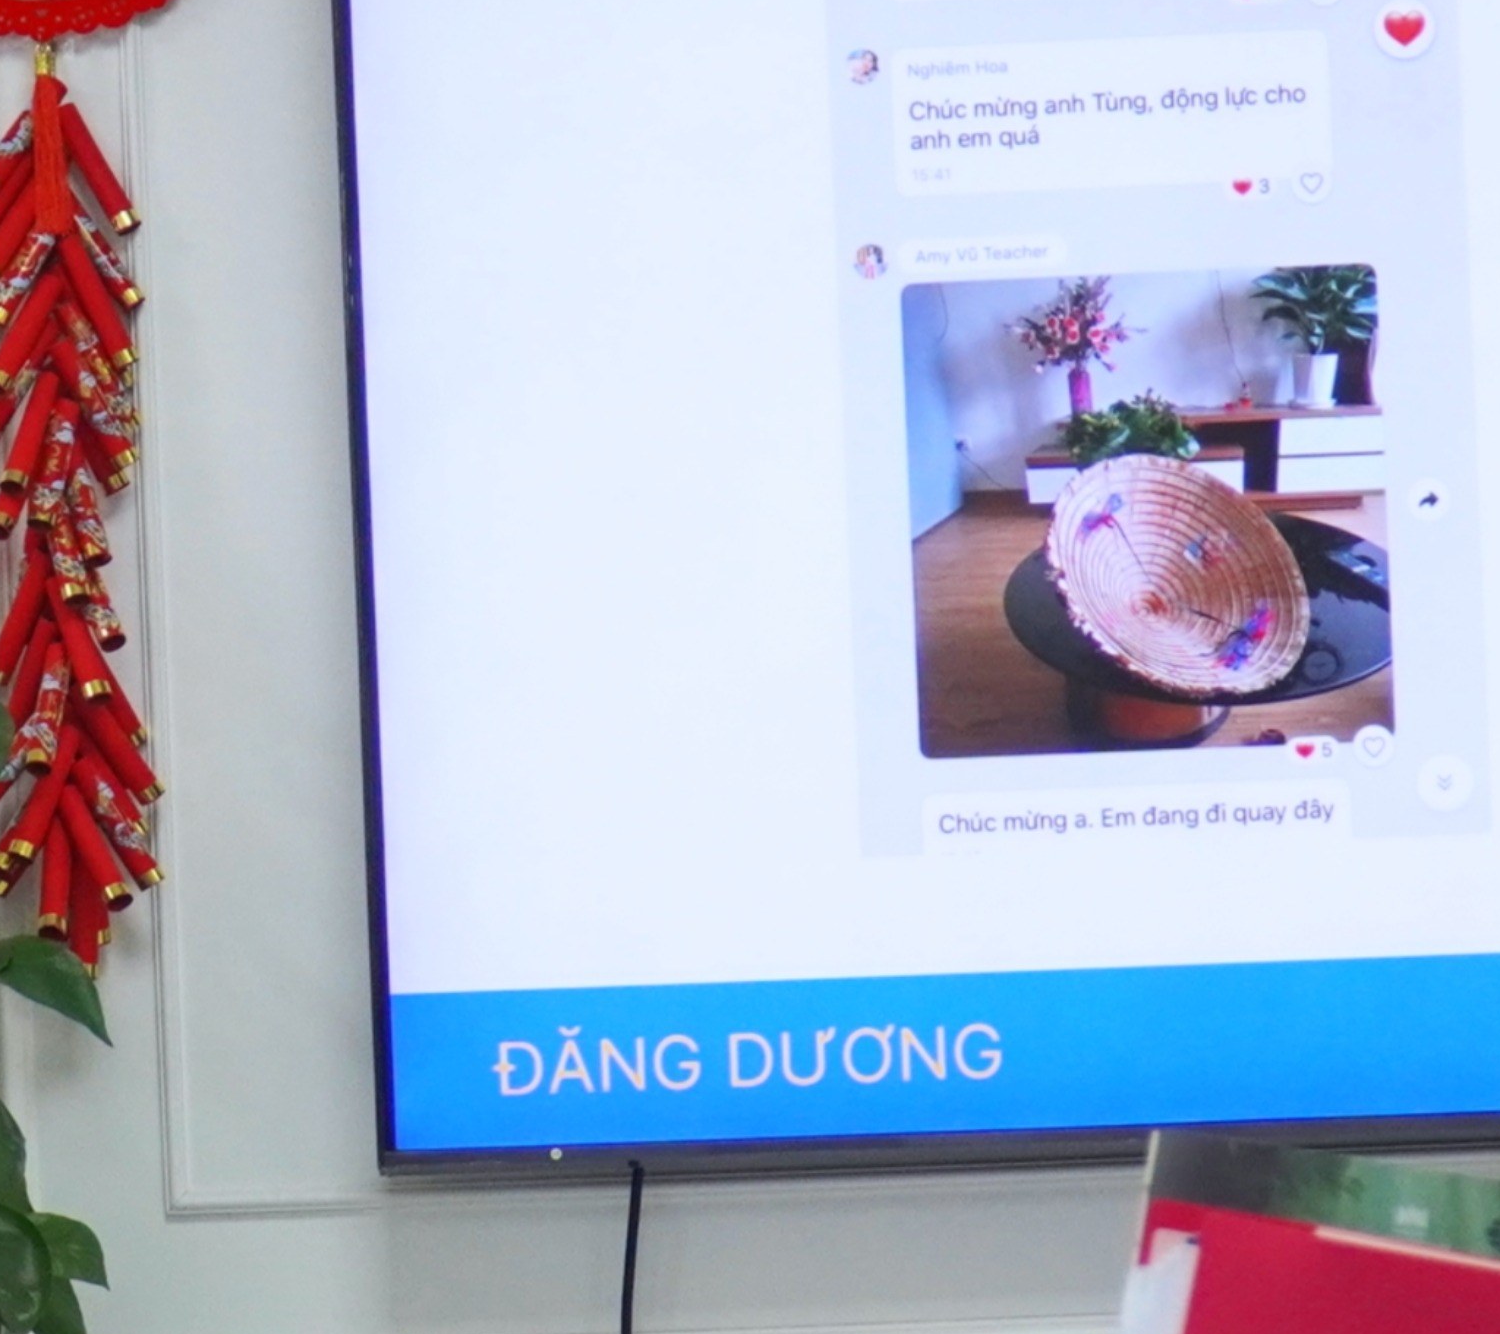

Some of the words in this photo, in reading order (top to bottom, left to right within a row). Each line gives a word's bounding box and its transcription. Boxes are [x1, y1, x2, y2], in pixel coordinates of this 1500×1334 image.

[974, 59, 1009, 75] Hoa
[908, 99, 967, 122] Chúc
[973, 96, 1038, 121] mừng
[1044, 94, 1086, 116] anh
[1091, 91, 1153, 116] Tùng,
[1160, 87, 1219, 114] động
[1224, 86, 1258, 111] lực
[1264, 84, 1307, 105] cho
[910, 129, 952, 151] anh
[957, 131, 993, 149] em
[998, 124, 1041, 150] quá
[1258, 177, 1271, 195] 3
[915, 249, 951, 266] Amy
[982, 244, 1049, 261] Teacher
[1321, 742, 1333, 758] 5
[938, 812, 997, 835] Chúc
[1002, 810, 1068, 835] mừng
[1074, 812, 1093, 830] a.
[1100, 807, 1136, 829] Em
[1141, 805, 1200, 830] đang
[1205, 802, 1227, 824] đi
[1232, 805, 1287, 826] quay
[1293, 798, 1334, 823] đây
[492, 1025, 702, 1097] ĐĂNG
[728, 1021, 1003, 1089] DƯƠNG
